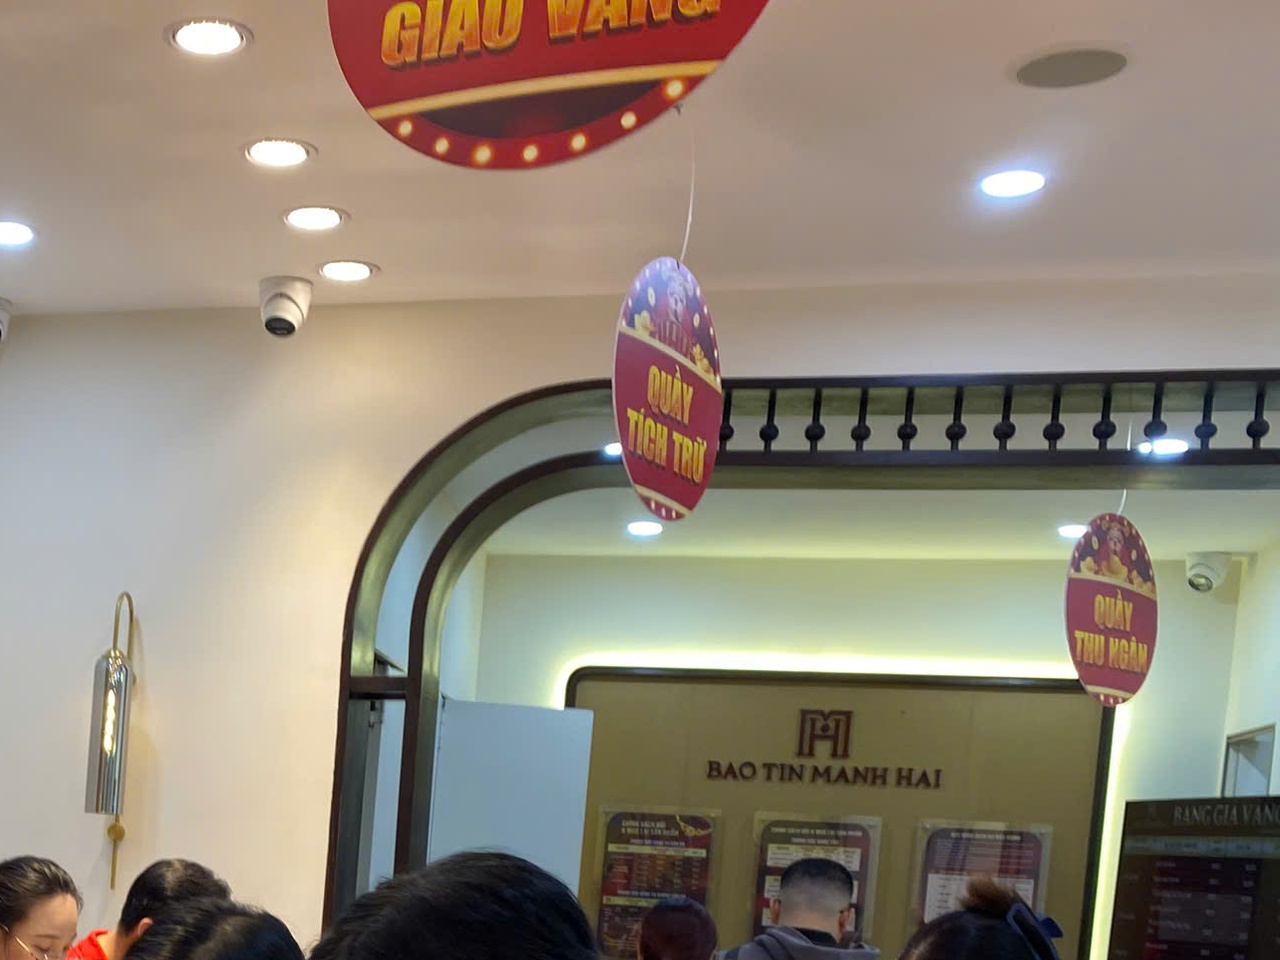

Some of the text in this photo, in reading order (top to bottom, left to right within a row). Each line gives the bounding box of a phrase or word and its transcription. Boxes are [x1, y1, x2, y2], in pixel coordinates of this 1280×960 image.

[626, 407, 707, 484] TÍCH TRỮ
[1074, 629, 1148, 674] THU NGÂN
